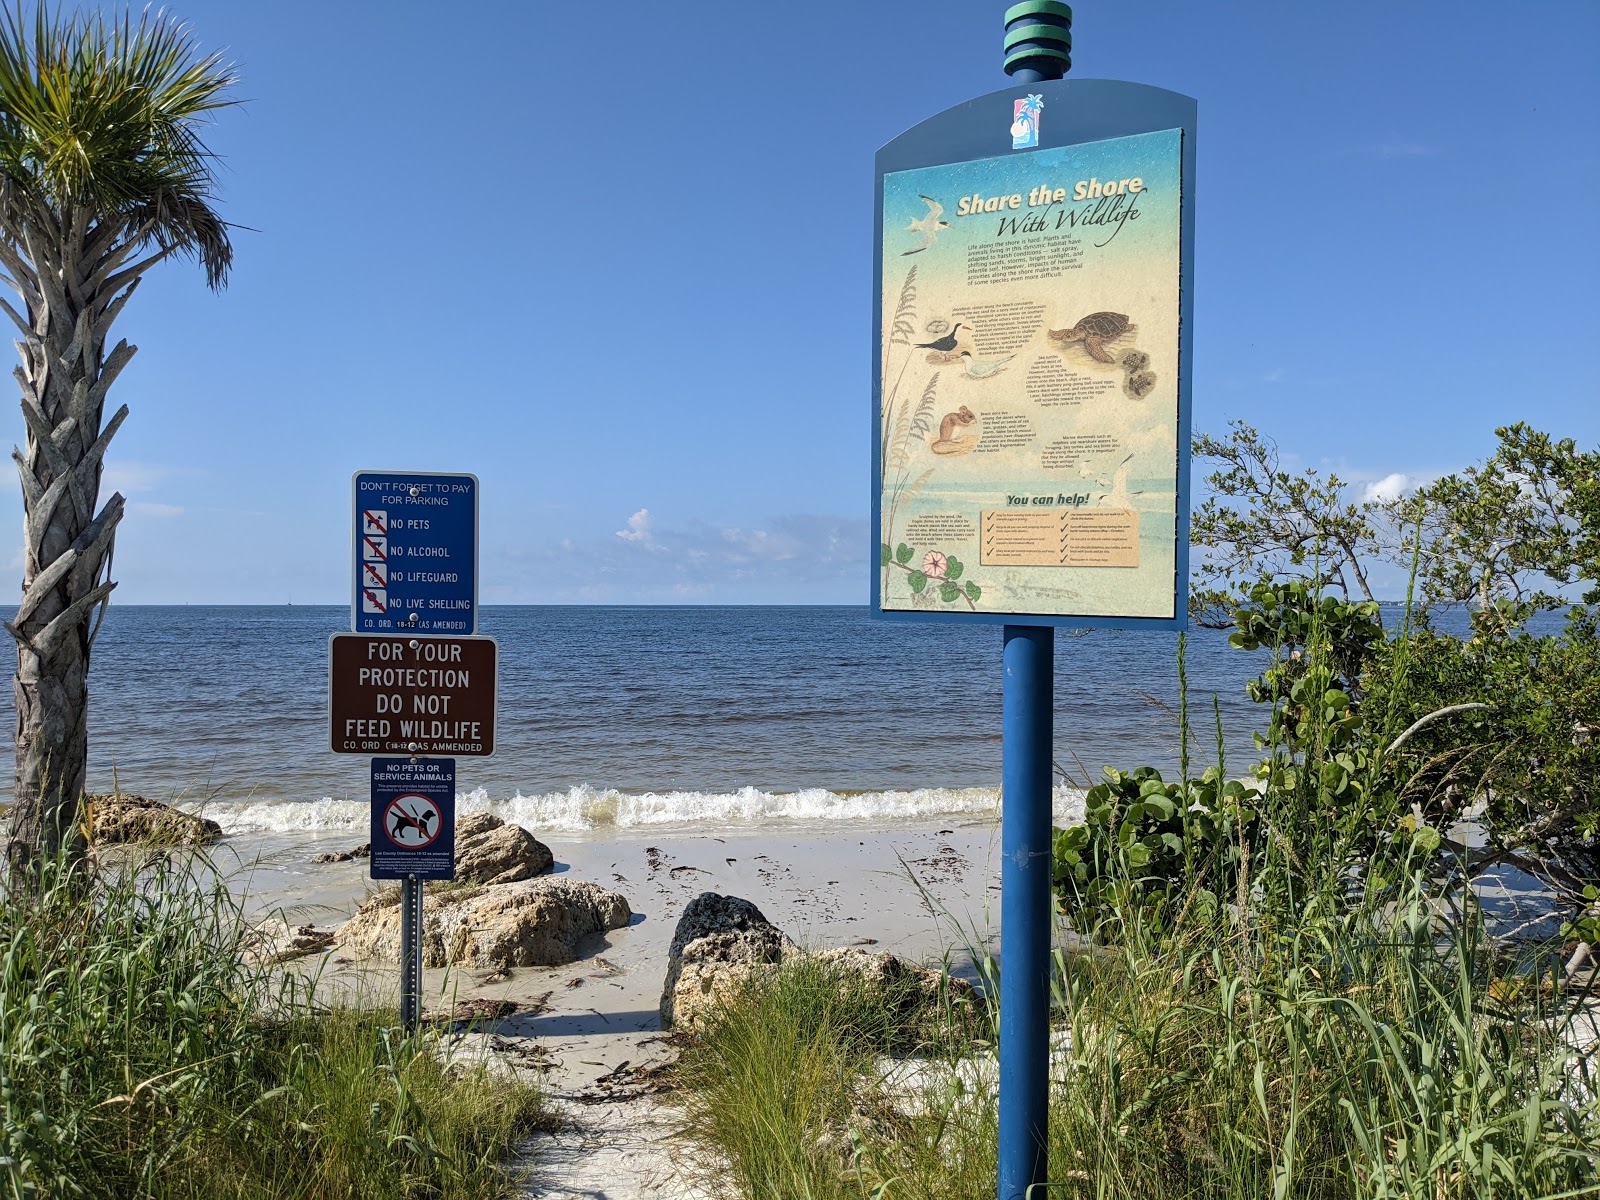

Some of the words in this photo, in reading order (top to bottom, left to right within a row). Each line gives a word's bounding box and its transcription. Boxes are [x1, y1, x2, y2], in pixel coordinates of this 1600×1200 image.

[957, 194, 1021, 216] Share
[1028, 184, 1066, 207] the
[1073, 177, 1142, 200] Shore
[997, 200, 1062, 237] With
[1055, 188, 1147, 247] Wildlife
[361, 482, 390, 490] DON'T
[393, 483, 433, 492] FORGET
[437, 484, 449, 492] TO
[452, 485, 470, 493] PAY
[382, 496, 402, 504] FOR
[405, 496, 448, 505] PARKING
[1007, 496, 1029, 505] You
[1032, 496, 1054, 505] can
[1057, 493, 1090, 507] help!
[391, 519, 403, 528] NO
[408, 520, 429, 529] PETS
[391, 546, 403, 556] NO
[408, 547, 450, 557] ALCOHOL
[391, 572, 403, 581] NO
[408, 572, 457, 582] LIFEGUARD
[390, 598, 402, 608] NO
[407, 599, 424, 608] LIVE
[429, 599, 470, 609] SHELLING
[433, 621, 466, 629] AMENDED)
[369, 642, 403, 660] FOR
[416, 642, 461, 662] YOUR
[360, 668, 469, 688] PROTECTION
[377, 694, 402, 713] DO
[414, 695, 451, 714] NOT
[346, 719, 390, 737] FEED
[400, 720, 480, 739] WILDLIFE
[417, 742, 428, 750] AS
[432, 743, 482, 751] AMMENDED
